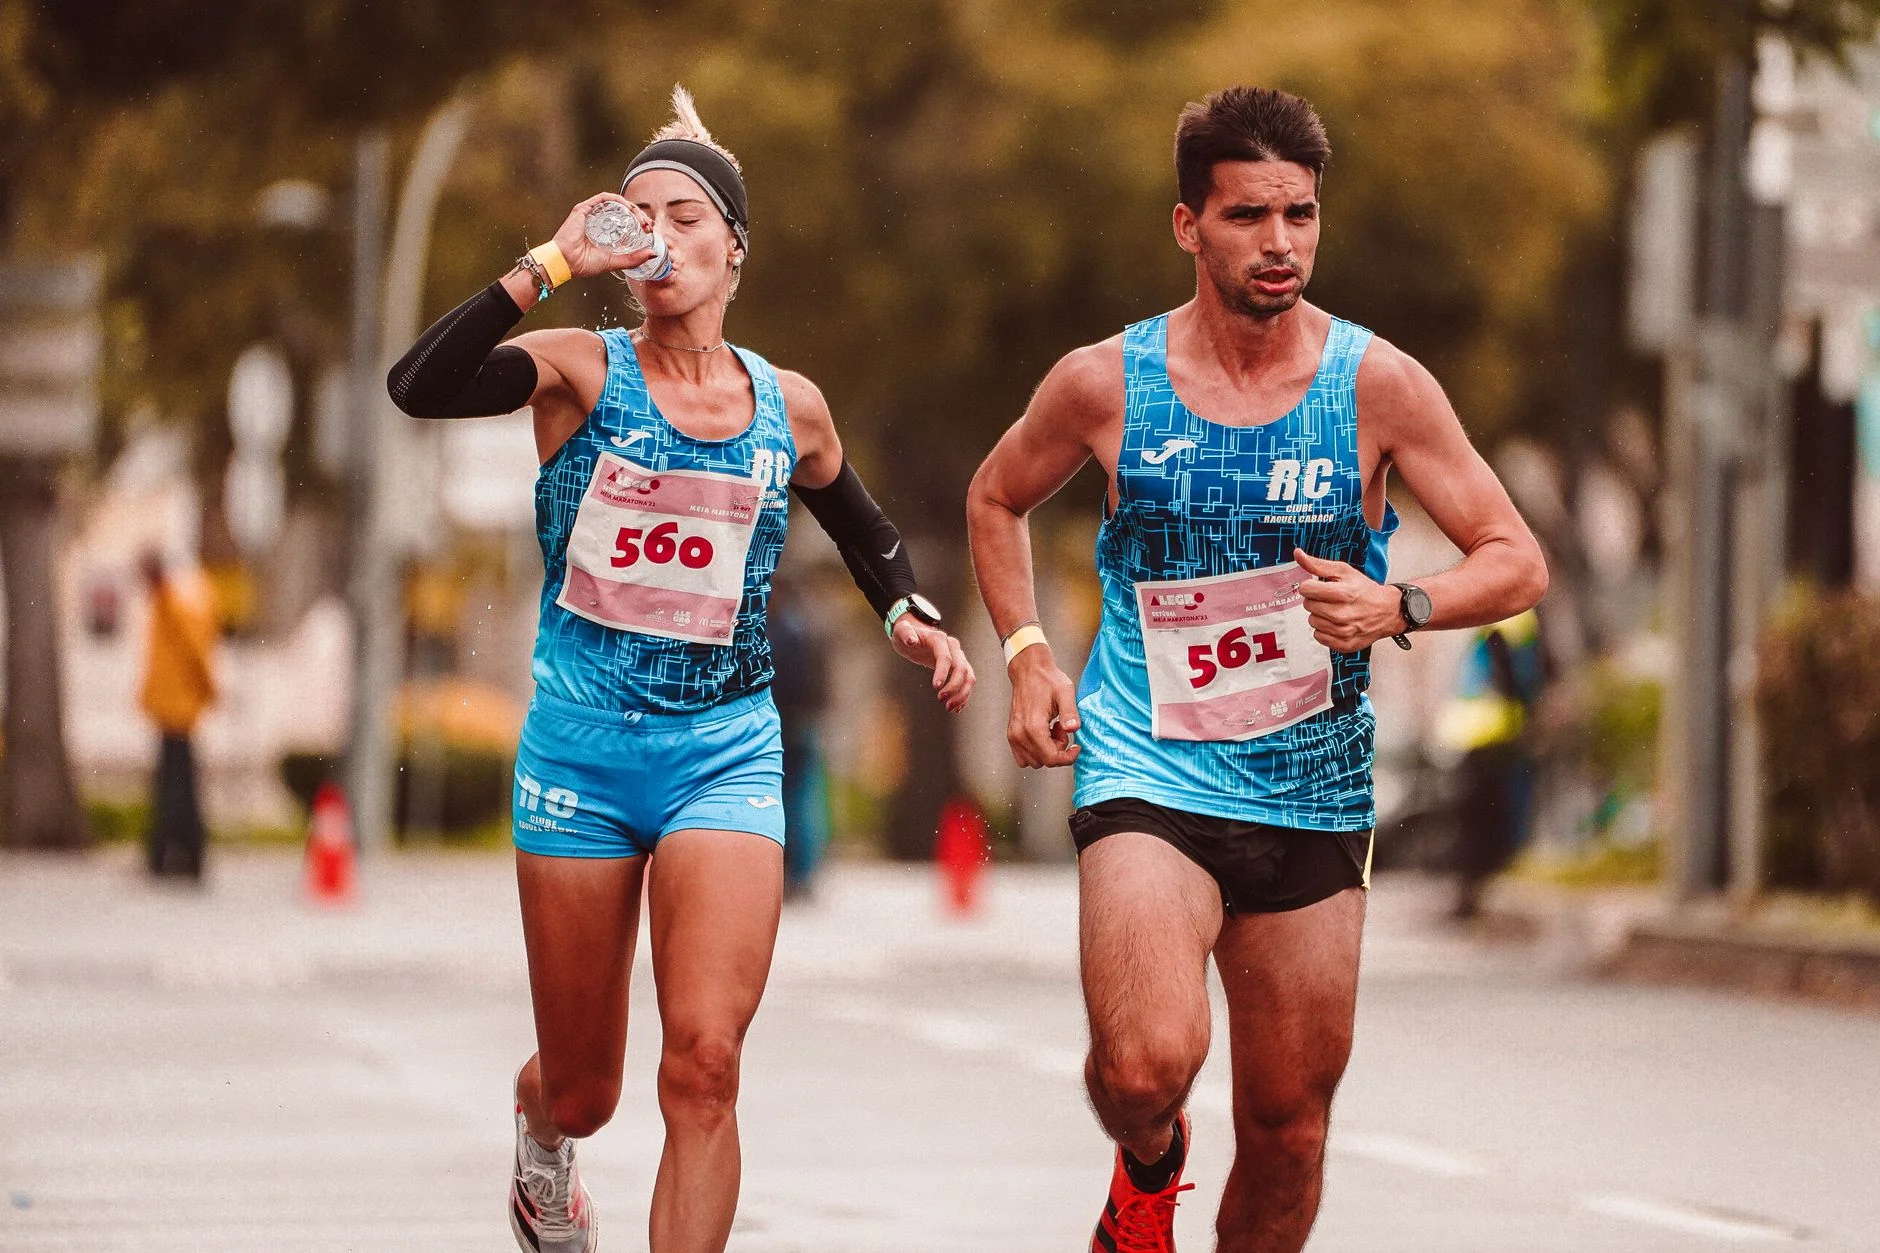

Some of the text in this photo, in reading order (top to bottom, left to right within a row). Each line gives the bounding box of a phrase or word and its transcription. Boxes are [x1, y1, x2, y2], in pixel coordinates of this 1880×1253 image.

[1265, 458, 1334, 501] RC
[689, 504, 710, 514] MEIA
[1286, 503, 1313, 512] CLUBE
[1263, 515, 1297, 524] RAQUEL
[610, 522, 714, 569] 560
[1245, 594, 1304, 612] MEIA MARATO
[1188, 626, 1286, 689] 561
[530, 815, 557, 828] CLUBE
